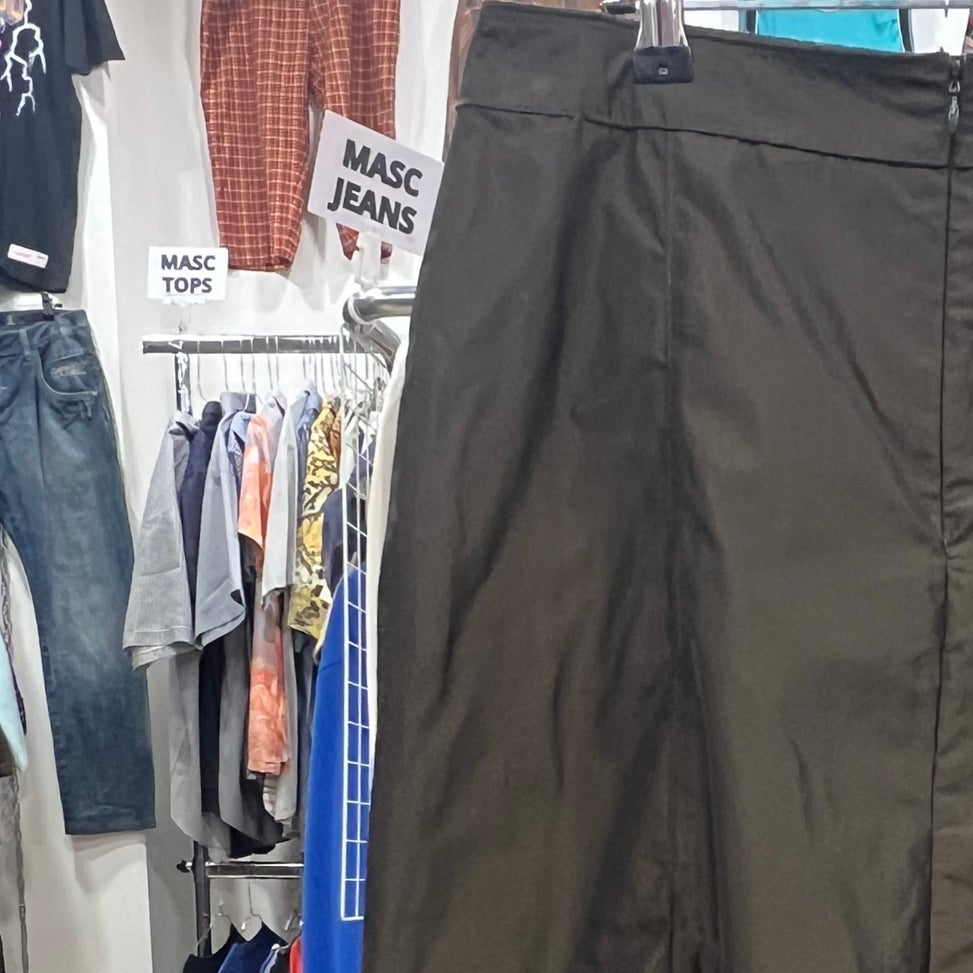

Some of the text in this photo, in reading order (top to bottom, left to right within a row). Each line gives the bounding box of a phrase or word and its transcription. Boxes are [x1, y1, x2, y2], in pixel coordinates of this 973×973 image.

[342, 138, 423, 197] MASC
[327, 177, 417, 234] JEANS
[161, 254, 216, 271] MASC
[162, 276, 212, 294] TOPS
